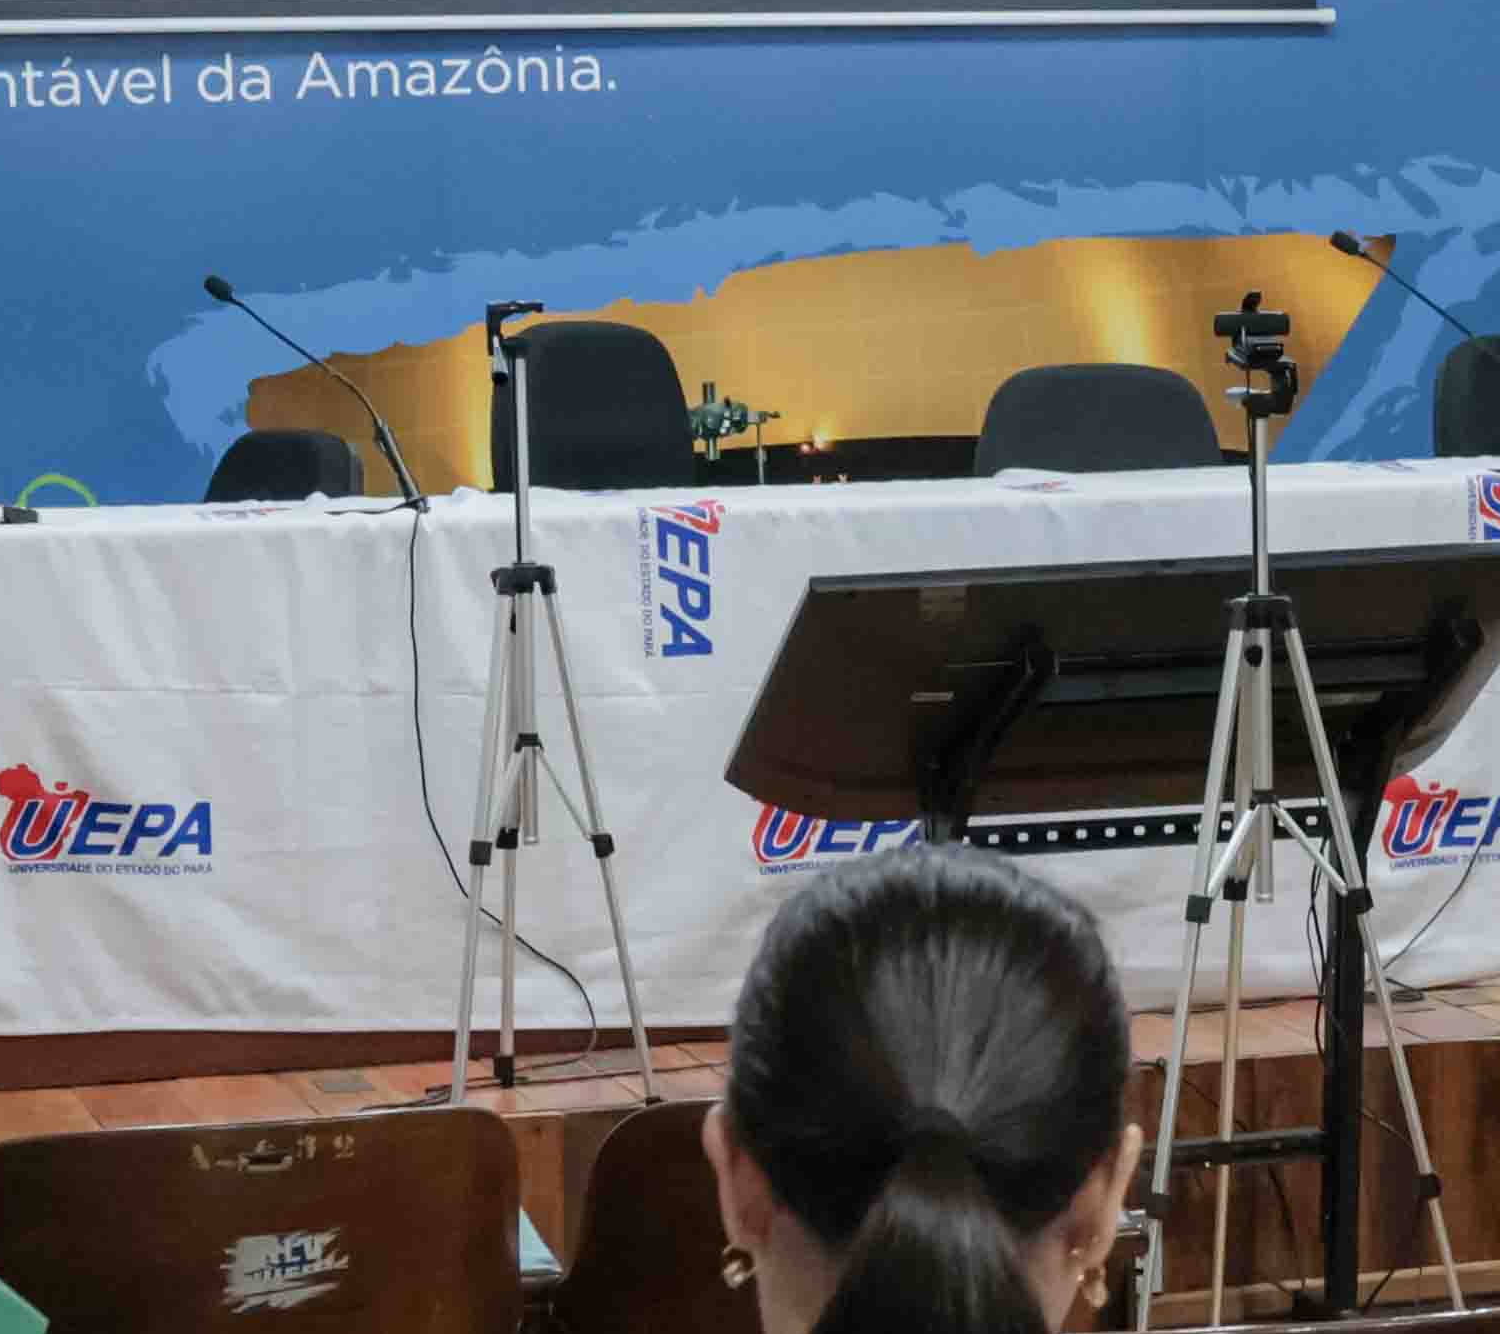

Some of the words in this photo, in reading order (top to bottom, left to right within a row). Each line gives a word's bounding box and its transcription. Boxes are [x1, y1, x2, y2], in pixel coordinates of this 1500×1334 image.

[197, 50, 274, 103] da
[297, 45, 618, 100] Amazônia.
[7, 799, 213, 857] UEPA
